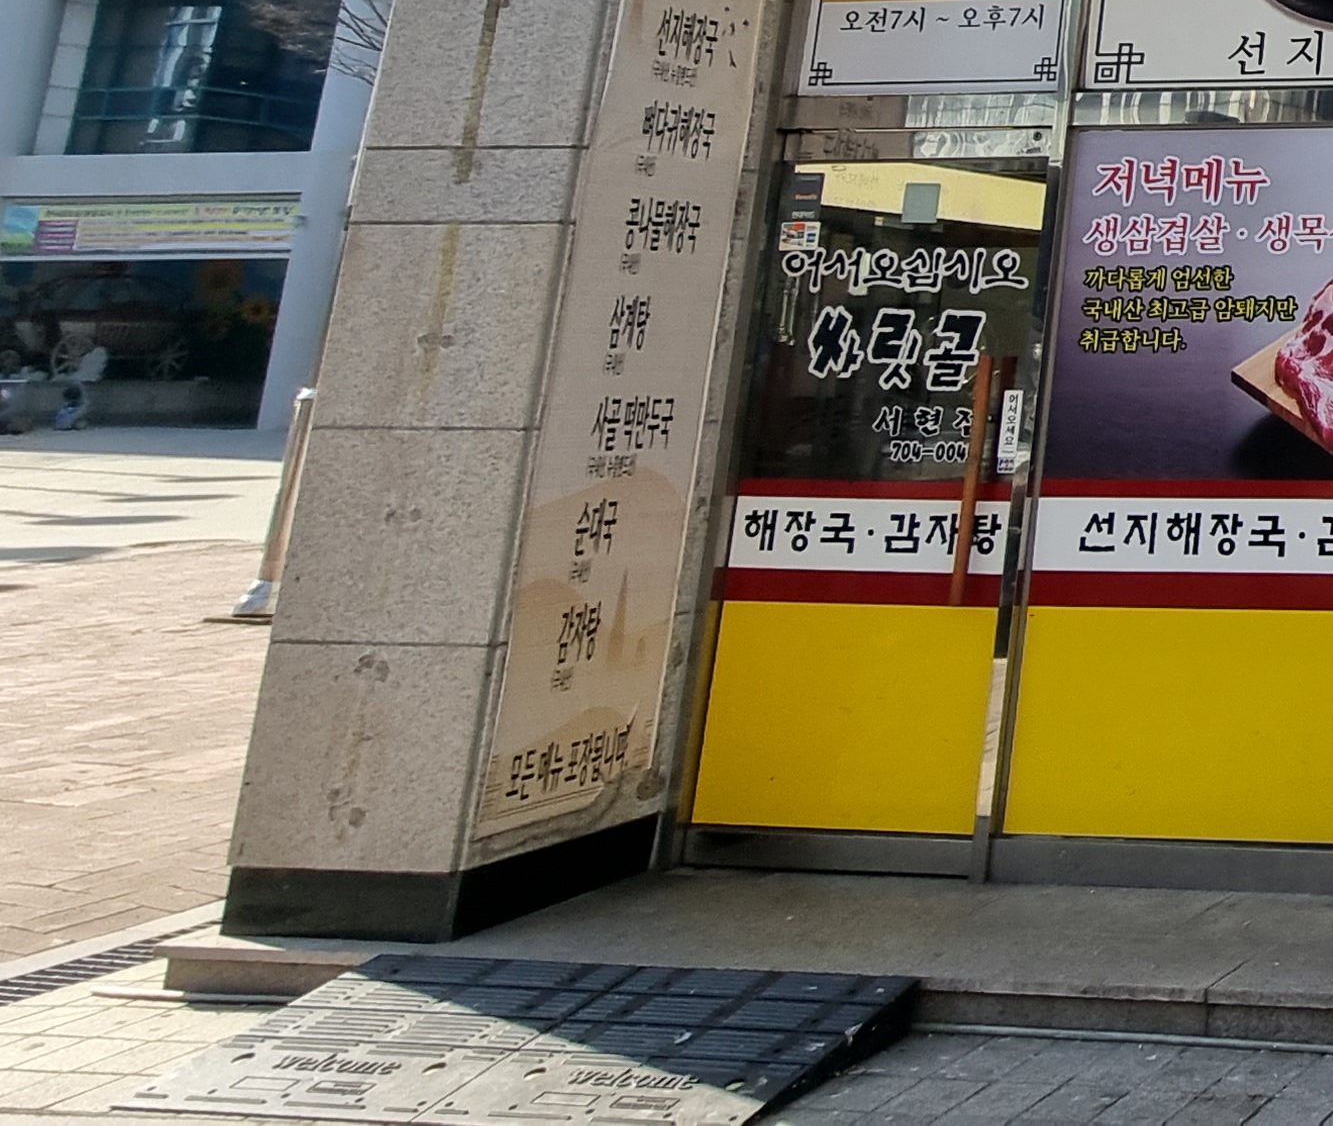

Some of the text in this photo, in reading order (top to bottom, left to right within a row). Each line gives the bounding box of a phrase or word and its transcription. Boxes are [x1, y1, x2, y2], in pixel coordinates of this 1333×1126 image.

[656, 6, 720, 68] 선지해장국
[840, 7, 925, 32] 오전7시
[958, 4, 1044, 30] 오후7시
[1092, 155, 1270, 206] 저녁메뉴
[624, 197, 701, 255] 콩나물해장국
[781, 247, 1029, 294] 어서오십시오
[1084, 265, 1234, 292] 까다롭게 엄선한
[609, 294, 652, 351] 삼계탕
[1081, 296, 1298, 323] 국내산 최고급 암돼지만
[808, 306, 986, 392] 싸릿골
[1078, 327, 1187, 353] 취급합니다.
[889, 440, 970, 464] 704-004
[574, 500, 618, 557] 순대국
[556, 601, 602, 665] 감자탕
